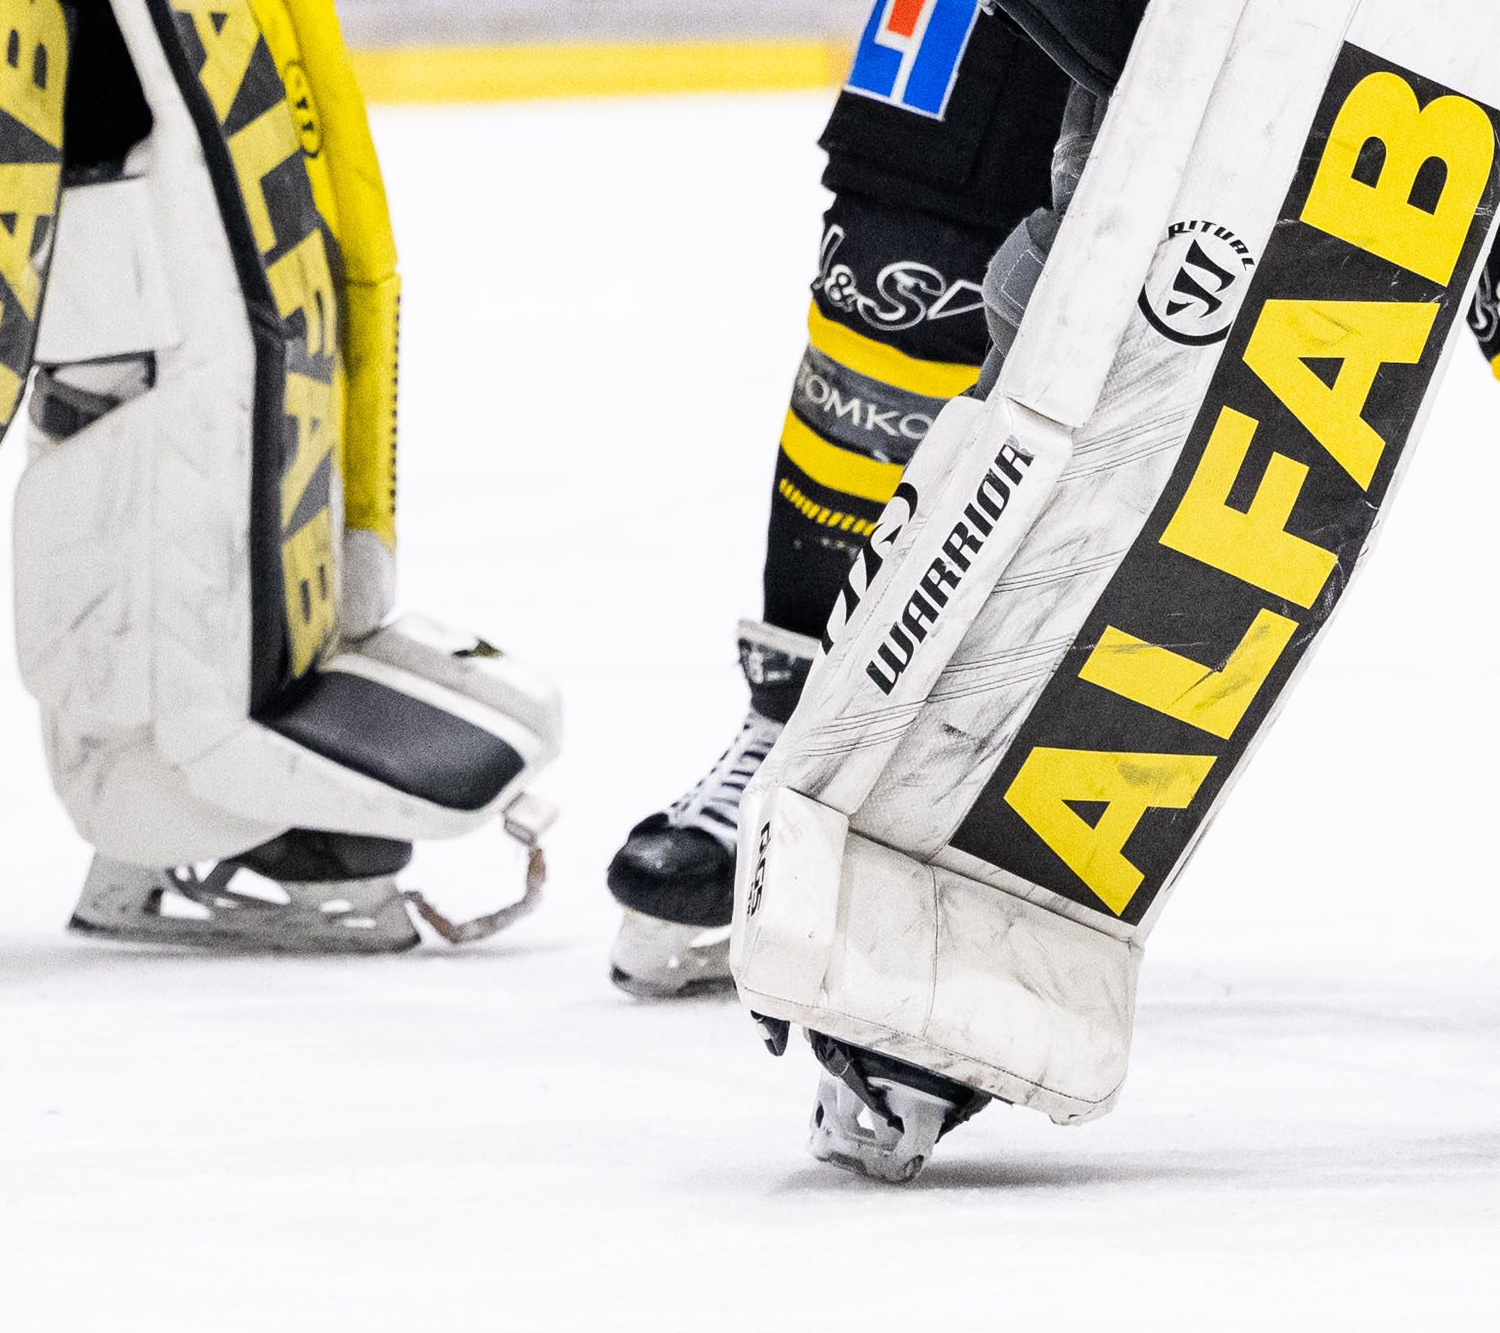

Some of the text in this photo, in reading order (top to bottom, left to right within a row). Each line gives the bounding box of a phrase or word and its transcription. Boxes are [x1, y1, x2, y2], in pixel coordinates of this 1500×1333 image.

[1167, 218, 1256, 272] RITUAL
[865, 440, 1036, 696] WARRIOR
[1003, 70, 1496, 918] ALFAB
